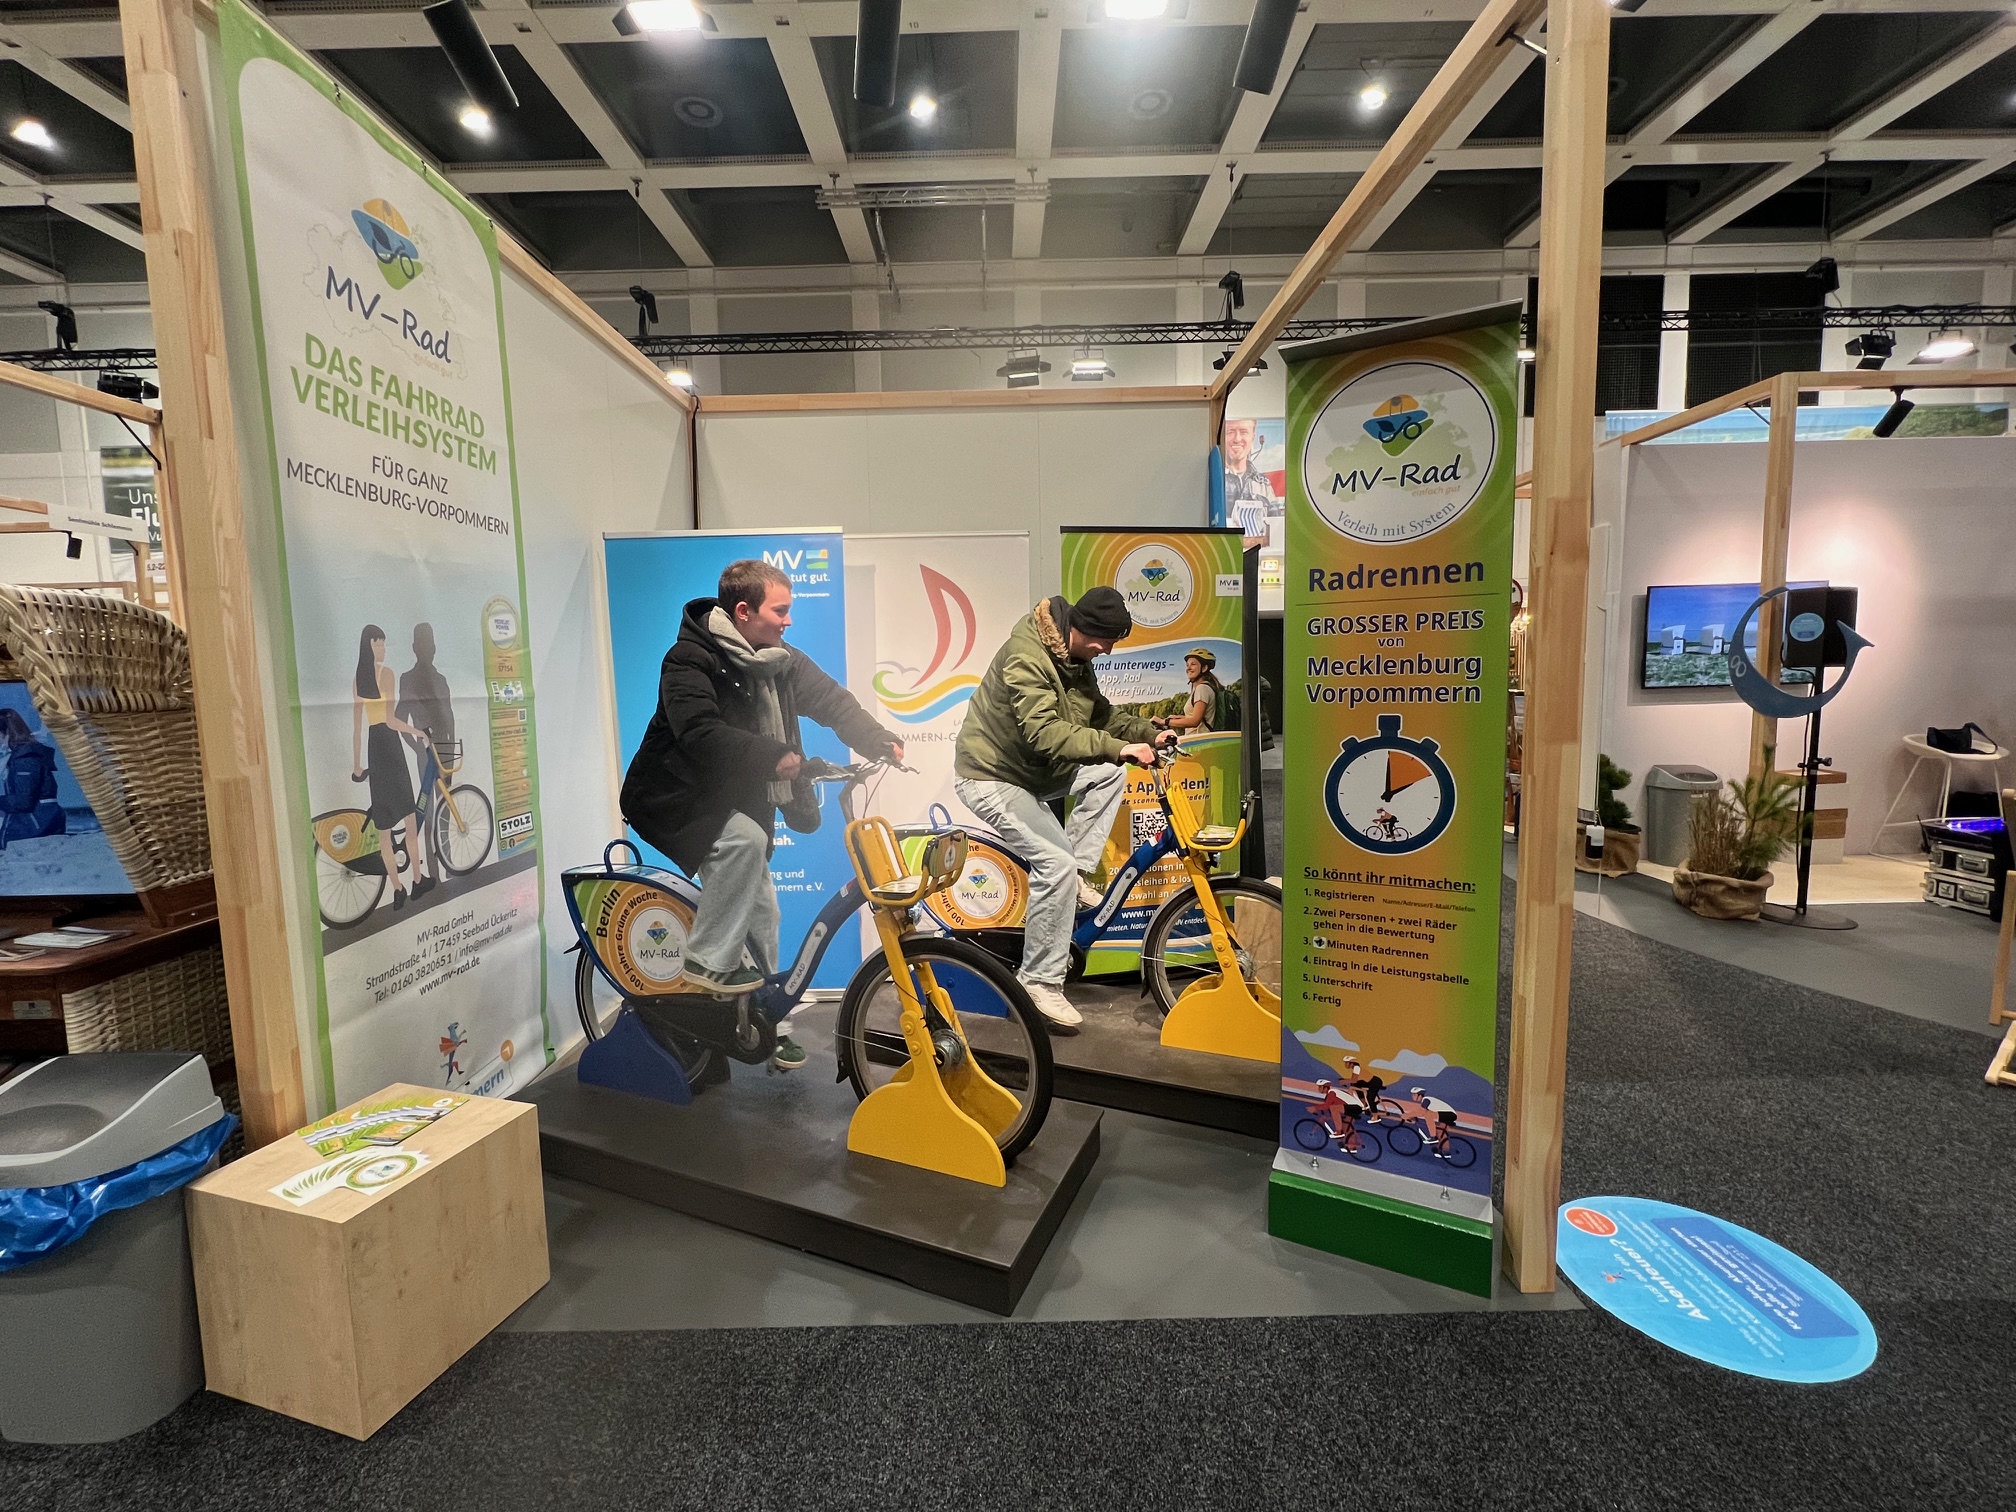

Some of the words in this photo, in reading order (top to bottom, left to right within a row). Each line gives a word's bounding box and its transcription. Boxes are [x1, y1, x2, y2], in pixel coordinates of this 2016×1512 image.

[326, 265, 451, 363] MV-Rad
[305, 332, 363, 388] DAS
[371, 364, 485, 439] FAHRRAD
[290, 365, 496, 476] VERLEIHSYSTEM
[372, 455, 404, 483] FÜR
[407, 468, 449, 495] GANZ
[1332, 454, 1461, 495] MV-Rad
[286, 457, 509, 536] MECKLENBURG-VORPOMMERN
[1412, 486, 1444, 497] einfach
[1445, 485, 1461, 497] gut
[1336, 510, 1377, 536] Verleih
[1383, 525, 1405, 537] mit
[1410, 502, 1456, 534] System
[763, 550, 803, 570] MV
[790, 573, 807, 582] tut
[810, 573, 831, 585] gut.
[1309, 561, 1484, 592] Radrennen
[1128, 590, 1180, 602] MV-Rad
[1307, 613, 1409, 635] GROSSER
[1415, 610, 1485, 631] PREIS
[1377, 636, 1404, 647] von
[1114, 661, 1166, 671] unterwegs
[1307, 653, 1482, 680] Mecklenburg
[1100, 674, 1121, 685] App,
[1123, 672, 1142, 683] Rad
[1108, 687, 1130, 697] Herz
[1131, 686, 1145, 698] für
[1147, 686, 1164, 696] MV.
[1306, 683, 1481, 709] Vorpommern
[501, 815, 530, 831] STOLZ
[785, 869, 804, 879] und
[1146, 863, 1173, 873] ionen
[1176, 862, 1184, 870] in
[1304, 867, 1319, 878] So
[1323, 868, 1362, 882] könnt
[1366, 871, 1385, 884] ihr
[1389, 874, 1476, 892] mitmachen:
[628, 890, 658, 909] Woche
[961, 891, 999, 899] MV-Rad
[1304, 888, 1311, 897] 1.
[1314, 888, 1375, 903] Registrieren
[596, 888, 621, 939] Berlin
[615, 908, 630, 941] Grüne
[951, 912, 965, 926] 100
[1304, 907, 1312, 915] 2.
[1313, 907, 1336, 918] Zwei
[1339, 910, 1386, 923] Personen
[1398, 917, 1422, 927] zwei
[1425, 919, 1458, 931] Räder
[417, 921, 450, 945] MV-Rad
[451, 910, 474, 930] GmbH
[1313, 920, 1344, 931] gehen
[1347, 924, 1356, 932] in
[1358, 924, 1374, 935] die
[1377, 927, 1435, 943] Bewertung
[366, 953, 420, 990] Strandstraße
[421, 948, 427, 960] 4
[434, 933, 460, 954] 17459
[463, 919, 490, 940] Seebad
[490, 908, 518, 927] Ückeritz
[617, 945, 633, 974] Jahre
[640, 948, 680, 959] MV-Rad
[1303, 937, 1311, 945] 3.
[1327, 939, 1369, 952] Minuten
[1372, 945, 1429, 960] Radrennen
[374, 988, 389, 1004] Tel:
[390, 972, 414, 994] 0160
[459, 924, 513, 957] info@mv-rad.de
[1303, 955, 1311, 964] 4.
[1313, 956, 1348, 971] Eintrag
[1351, 961, 1360, 970] in
[1363, 962, 1379, 973] die
[1382, 965, 1469, 985] Leistungstabelle
[419, 956, 481, 996] www.mv-rad.de
[629, 974, 645, 991] 100
[1302, 974, 1311, 983] 5.
[1313, 975, 1373, 991] Unterschrift
[1302, 991, 1311, 1000] 6.
[1313, 993, 1342, 1007] Fertig
[1614, 1253, 1630, 1267] ein
[1609, 1238, 1711, 1321] Abenteuer?
[1624, 1268, 1647, 1283] auf
[1644, 1284, 1670, 1303] Lust
